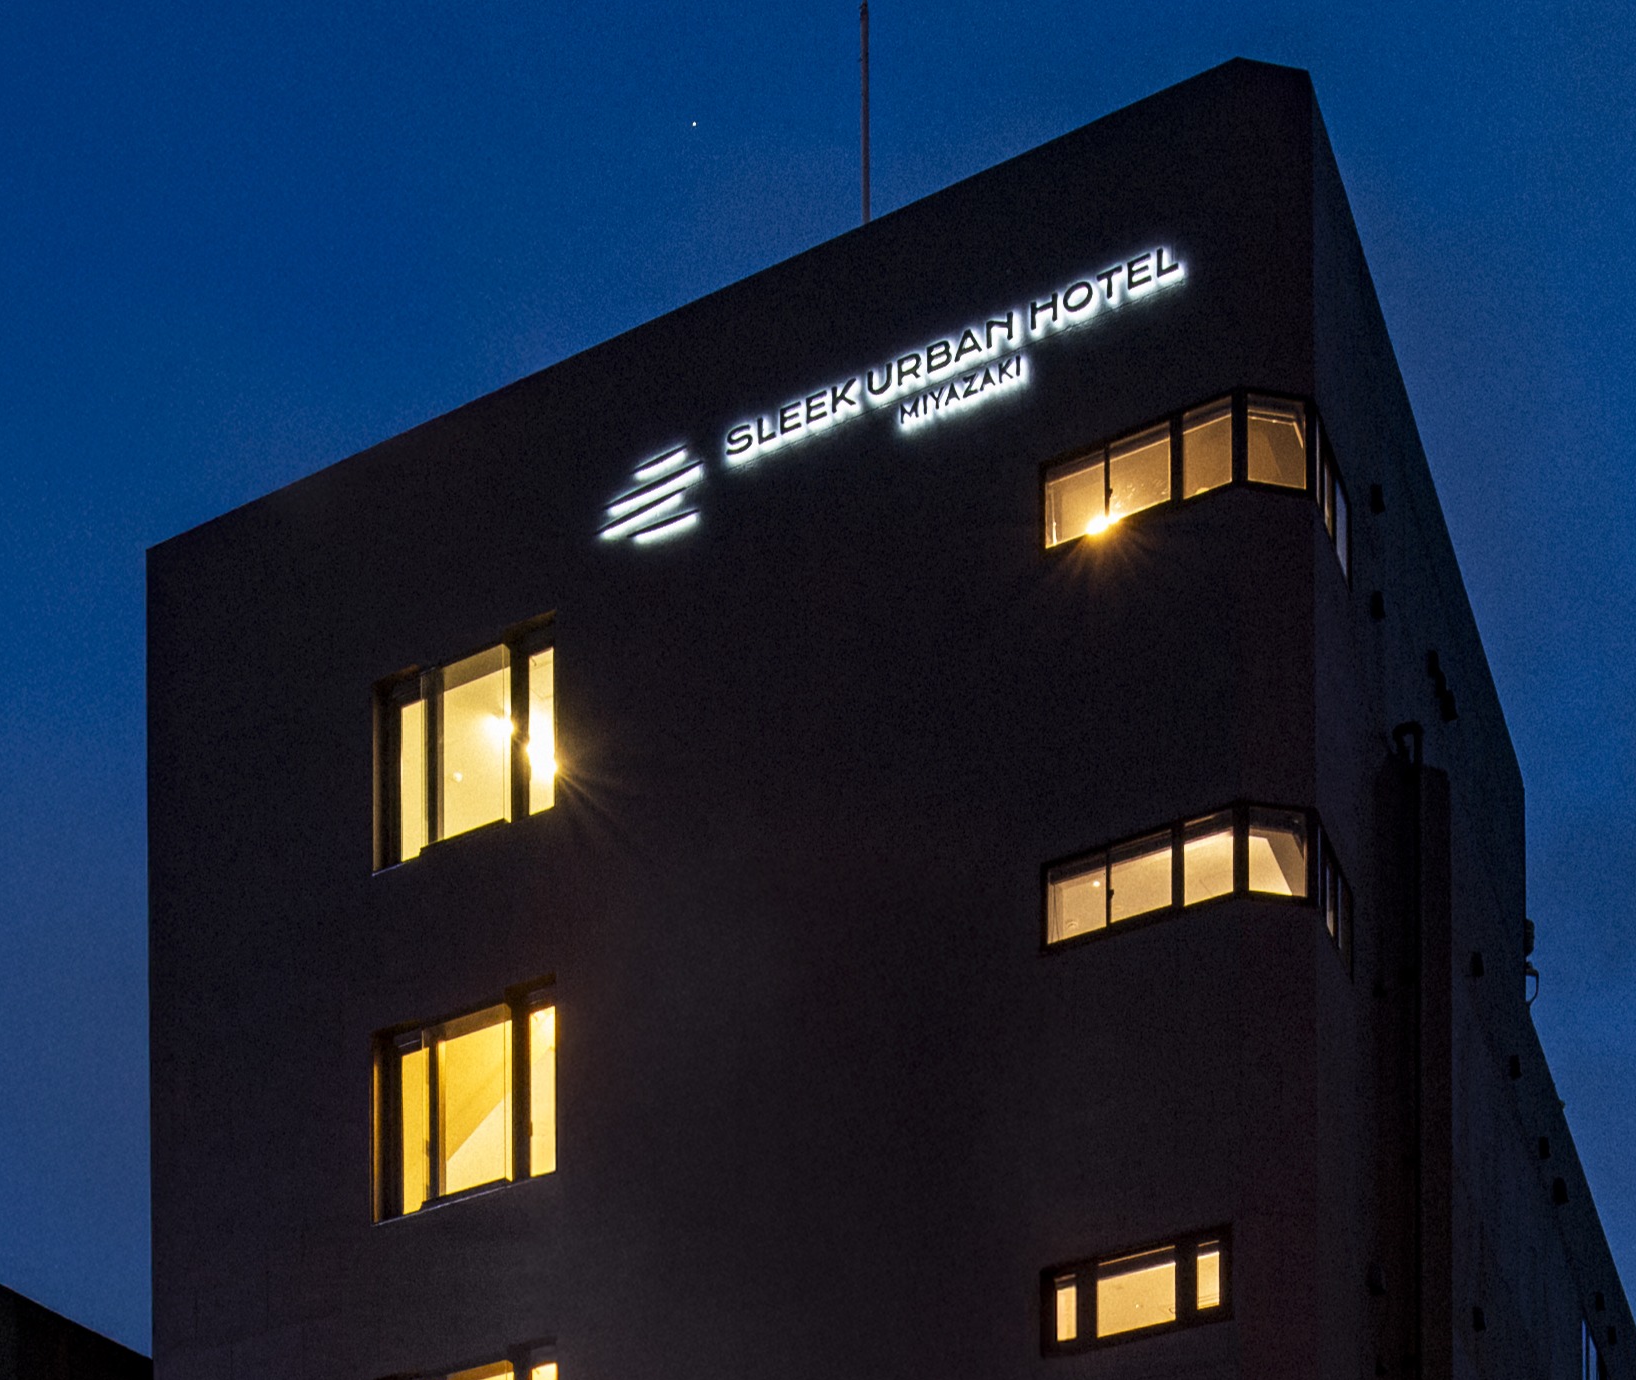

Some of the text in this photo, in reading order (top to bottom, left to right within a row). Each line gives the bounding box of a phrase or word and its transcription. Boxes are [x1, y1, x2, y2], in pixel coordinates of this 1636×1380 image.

[726, 248, 1179, 456] SLEEK URBAN HOTEL
[899, 354, 1022, 425] MIYAZAKI
